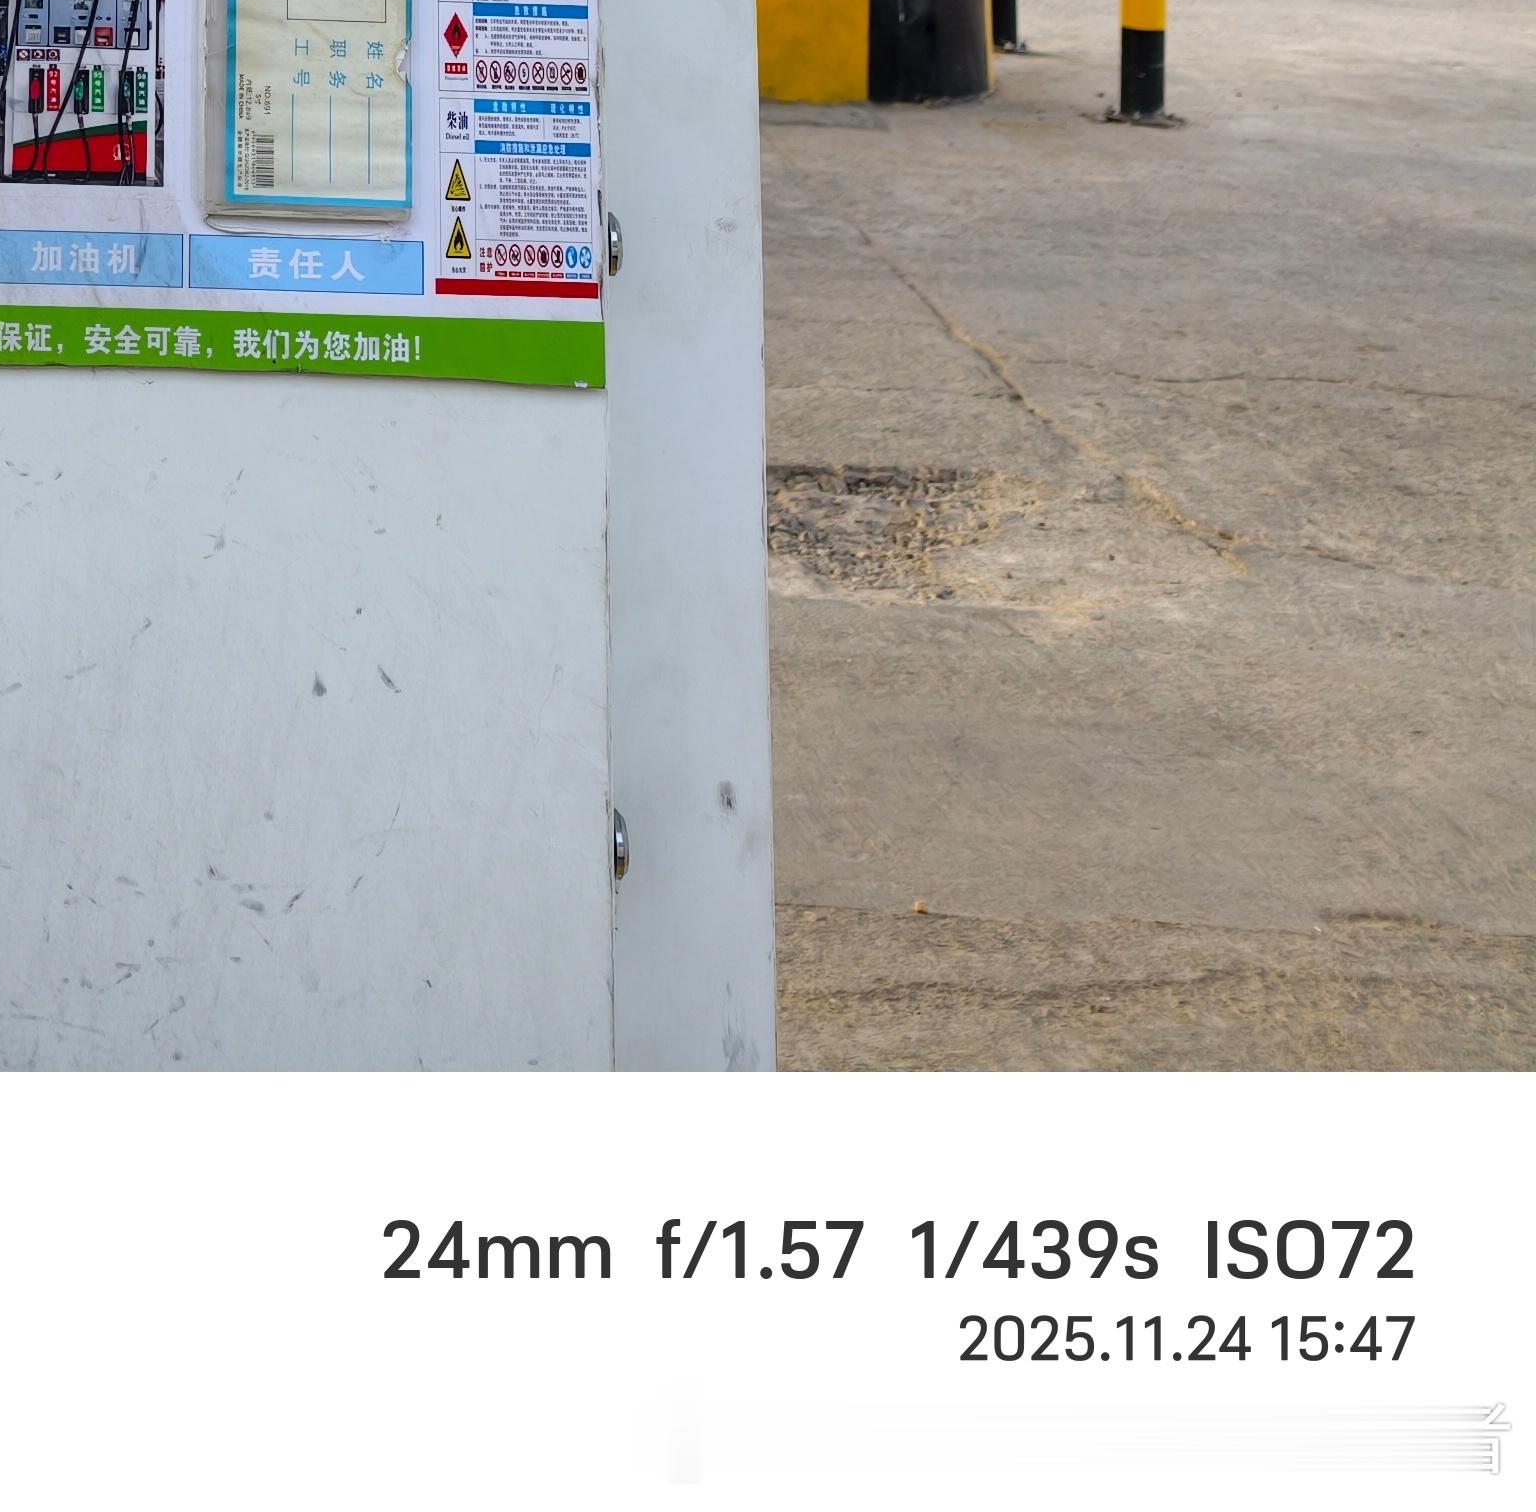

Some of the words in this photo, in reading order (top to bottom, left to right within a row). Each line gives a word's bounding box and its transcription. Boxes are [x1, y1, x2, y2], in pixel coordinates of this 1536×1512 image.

[292, 37, 311, 88] 工号
[328, 38, 348, 88] 职务
[366, 40, 385, 90] 姓名
[263, 85, 272, 116] NO.691
[445, 132, 462, 140] Diesel
[446, 110, 469, 130] 柴油
[31, 239, 141, 276] 加油机
[247, 245, 366, 283] 责任人
